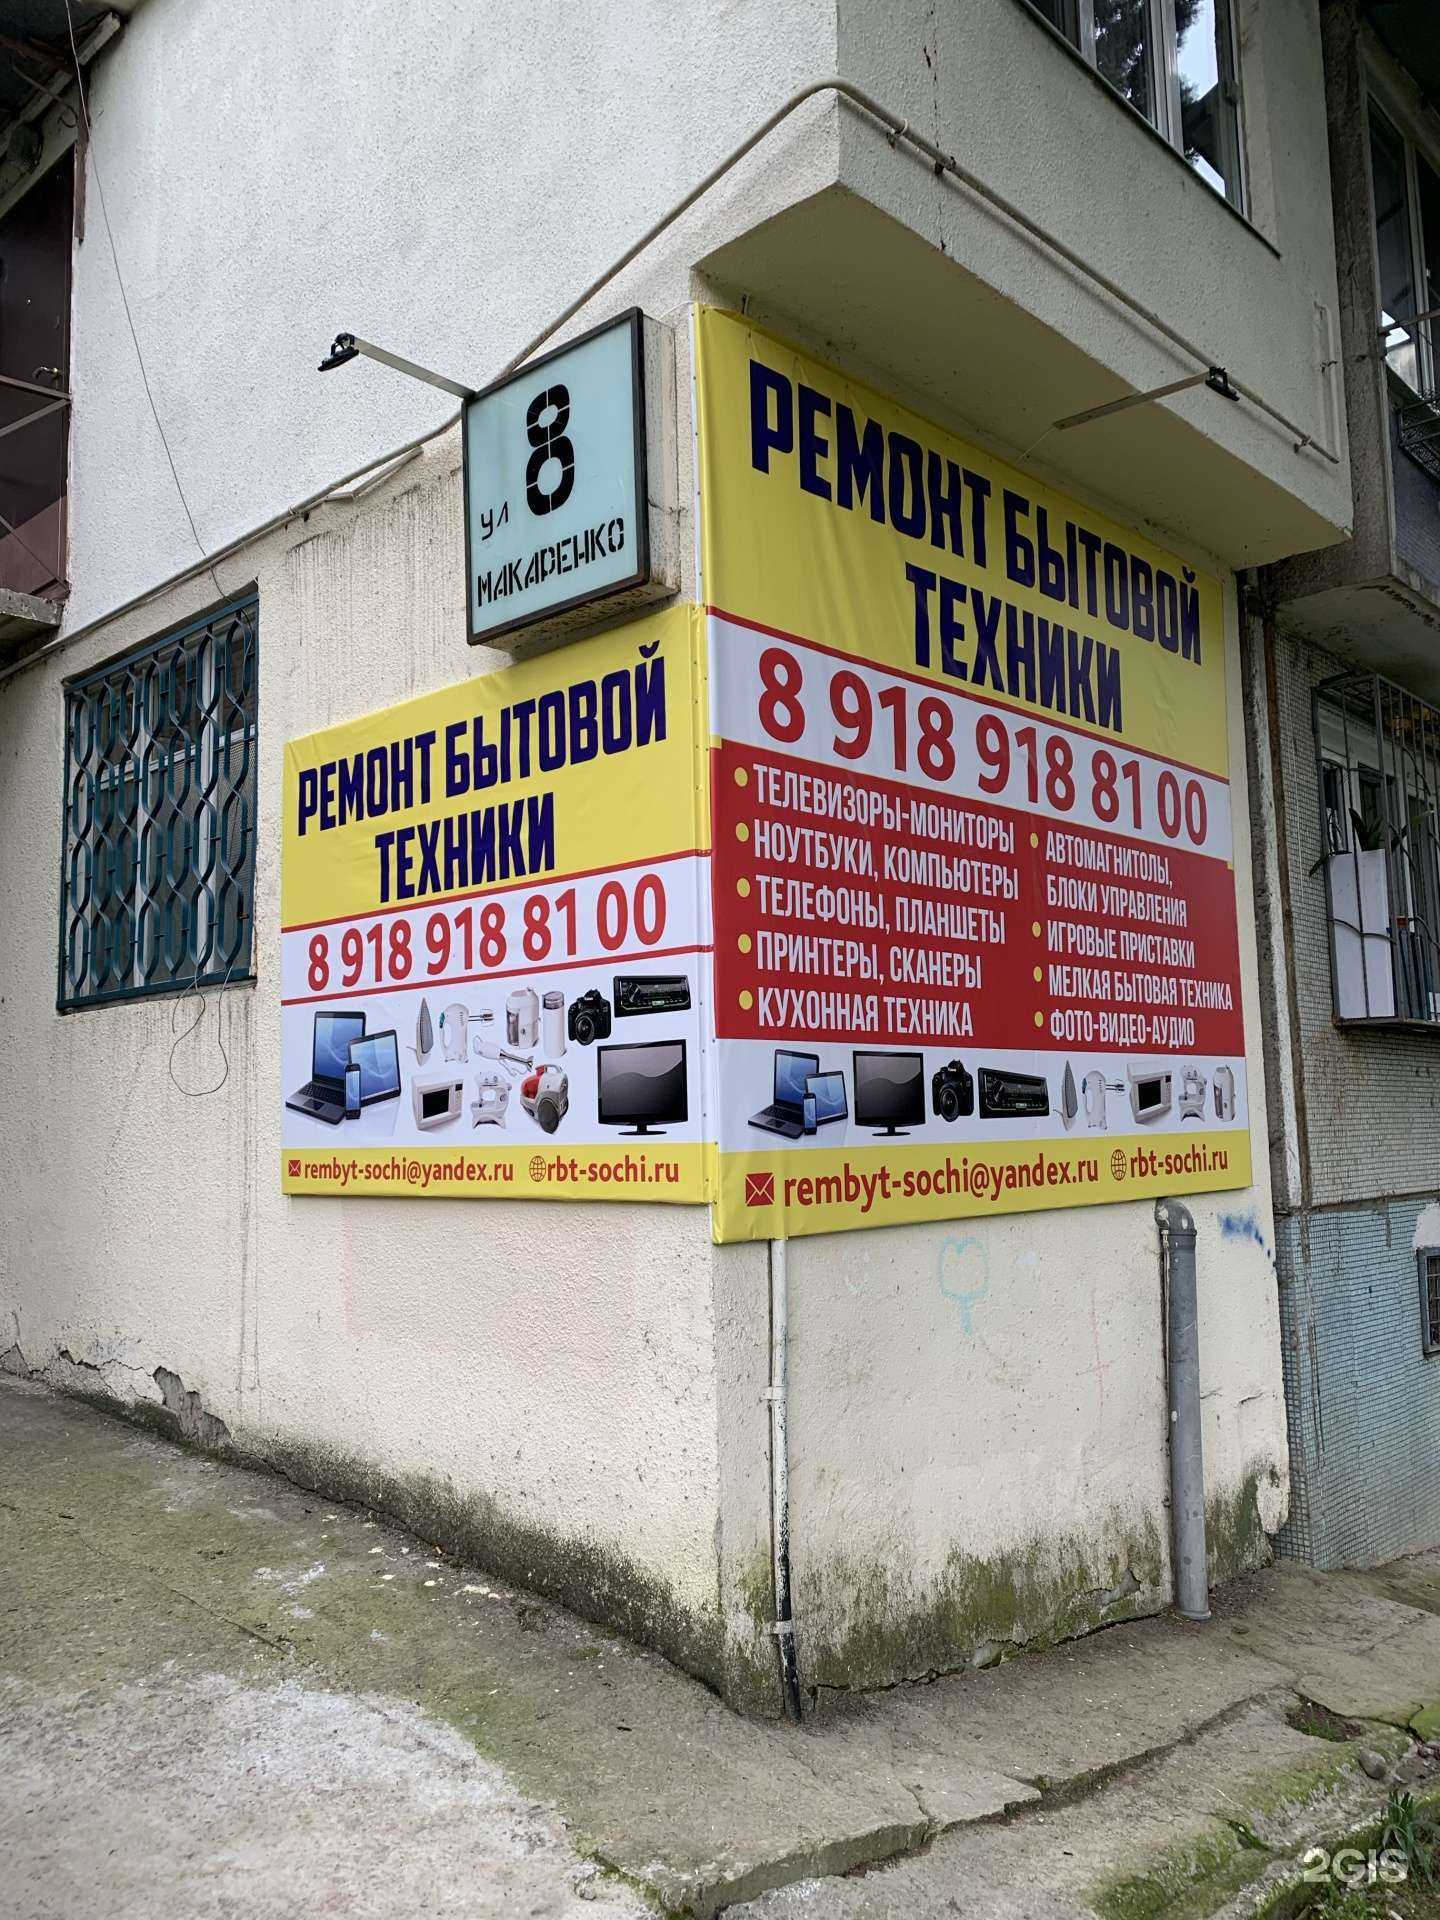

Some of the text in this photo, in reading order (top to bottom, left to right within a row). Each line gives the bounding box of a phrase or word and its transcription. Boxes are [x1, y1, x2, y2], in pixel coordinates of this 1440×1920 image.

[526, 384, 575, 516] 8
[749, 358, 1202, 666] РЕМОНТ БЫТОВОЙ
[478, 517, 625, 608] МАКАРЕНКО
[905, 561, 1123, 734] ТЕХНИКИ
[298, 639, 668, 837] РЕМОНТ БЫТОВОЙ
[758, 646, 1208, 847] 8 918 918 81 00
[374, 791, 555, 904] ТЕХНИКИ
[753, 763, 1015, 855] ТЕЛЕВИЗОРЫ-МОНИТОРЫ
[754, 818, 1019, 901] НОУТБУКИ, КОМПЬЮТЕРЫ
[1046, 830, 1173, 889] АВТОМАГНИТОЛЫ,
[307, 872, 667, 992] 8 918 918 81 00
[755, 874, 1006, 945] ТЕЛЕФОНЫ, ПЛАНШЕТЫ
[1047, 874, 1187, 928] БЛОКИ УПРАВЛЕНИЯ
[756, 929, 982, 990] ПРИНТЕРЫ, СКАНЕРЫ
[1047, 919, 1195, 969] ИГРОВЫЕ ПРИСТАВКИ
[757, 986, 974, 1037] КУХОННАЯ ТЕХНИКА
[1049, 964, 1233, 1011] МЕЛКАЯ БЫТОВАЯ ТЕХНИКА
[1050, 1008, 1195, 1048] ФОТО-ВИДЕО-АУДИО
[303, 1154, 680, 1188] rembyt-sochi@yandex.ru rbt-sochi.ru
[783, 1143, 1229, 1214] rembyt-sochi@yandex.ru rbt-sochi.ru
